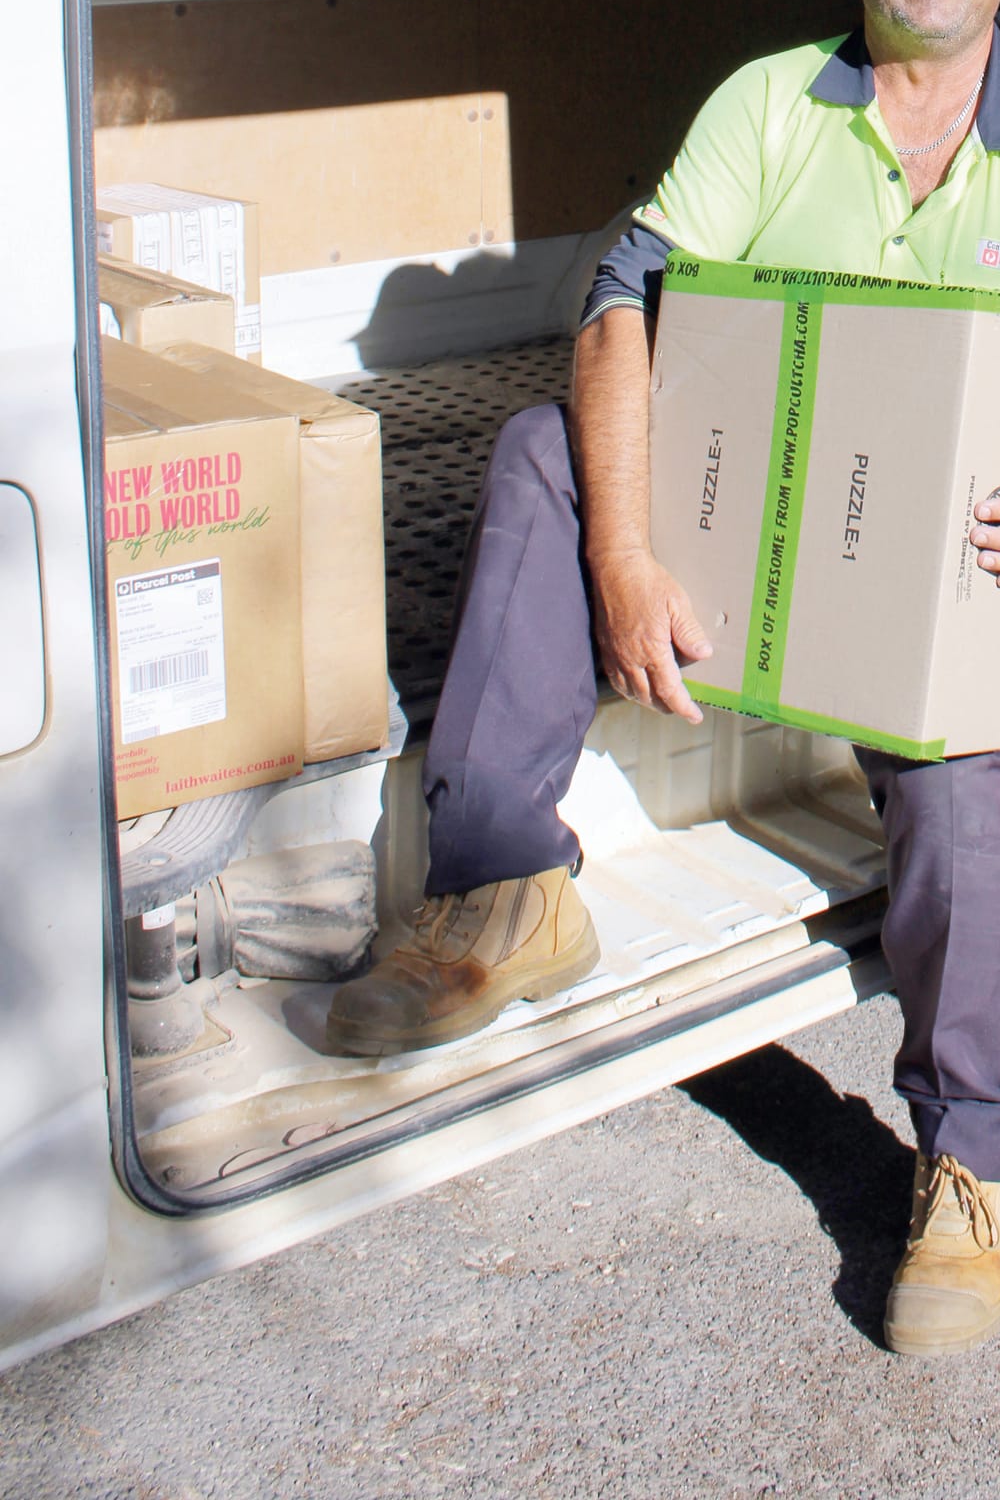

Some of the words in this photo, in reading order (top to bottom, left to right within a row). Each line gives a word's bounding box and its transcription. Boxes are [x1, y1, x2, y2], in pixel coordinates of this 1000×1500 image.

[677, 261, 700, 278] BOX
[753, 268, 892, 289] WWWPOPCULTCHA.COM
[781, 300, 810, 479] WWW.POPCULTCHA.COM
[104, 465, 153, 504] NEW
[160, 452, 242, 495] WORLD
[699, 428, 724, 531] PUZZLE-1
[105, 503, 151, 541] OLD
[159, 488, 241, 533] WORLD
[207, 506, 271, 536] world
[775, 484, 792, 529] FROM
[842, 453, 869, 561] PUZZLE-1
[134, 574, 169, 591] Parcel
[170, 568, 196, 584] Post
[765, 532, 785, 610] AWESOME
[762, 611, 776, 634] OF
[757, 638, 773, 672] BOX
[165, 754, 295, 793] laithwaites.com.au
